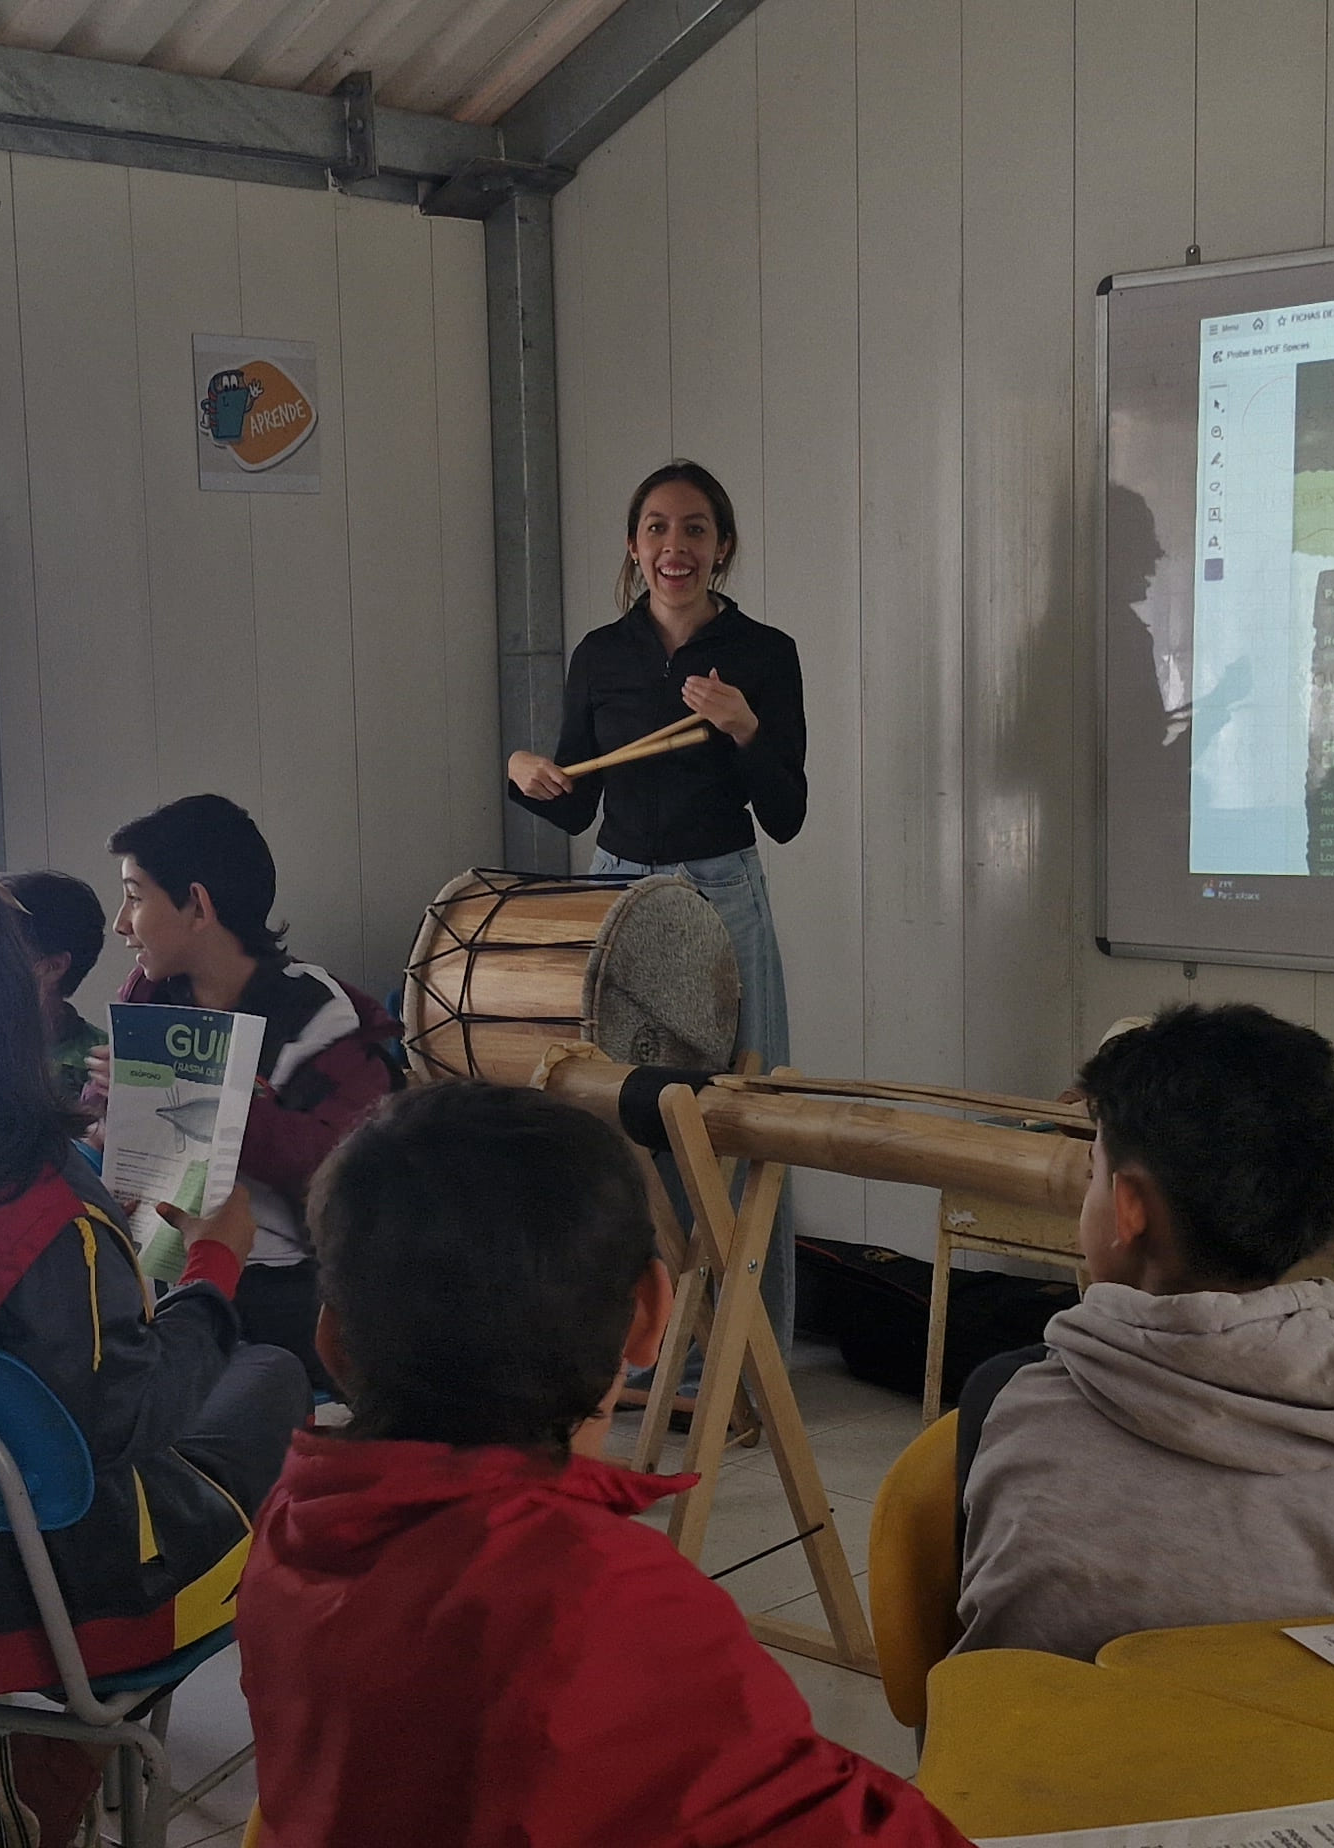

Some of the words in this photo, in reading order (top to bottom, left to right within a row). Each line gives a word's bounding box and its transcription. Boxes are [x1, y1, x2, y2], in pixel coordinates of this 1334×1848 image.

[1290, 308, 1321, 323] FICHAS
[1264, 344, 1281, 355] PDF
[249, 399, 307, 438] APRENDE
[1321, 789, 1334, 800] Se
